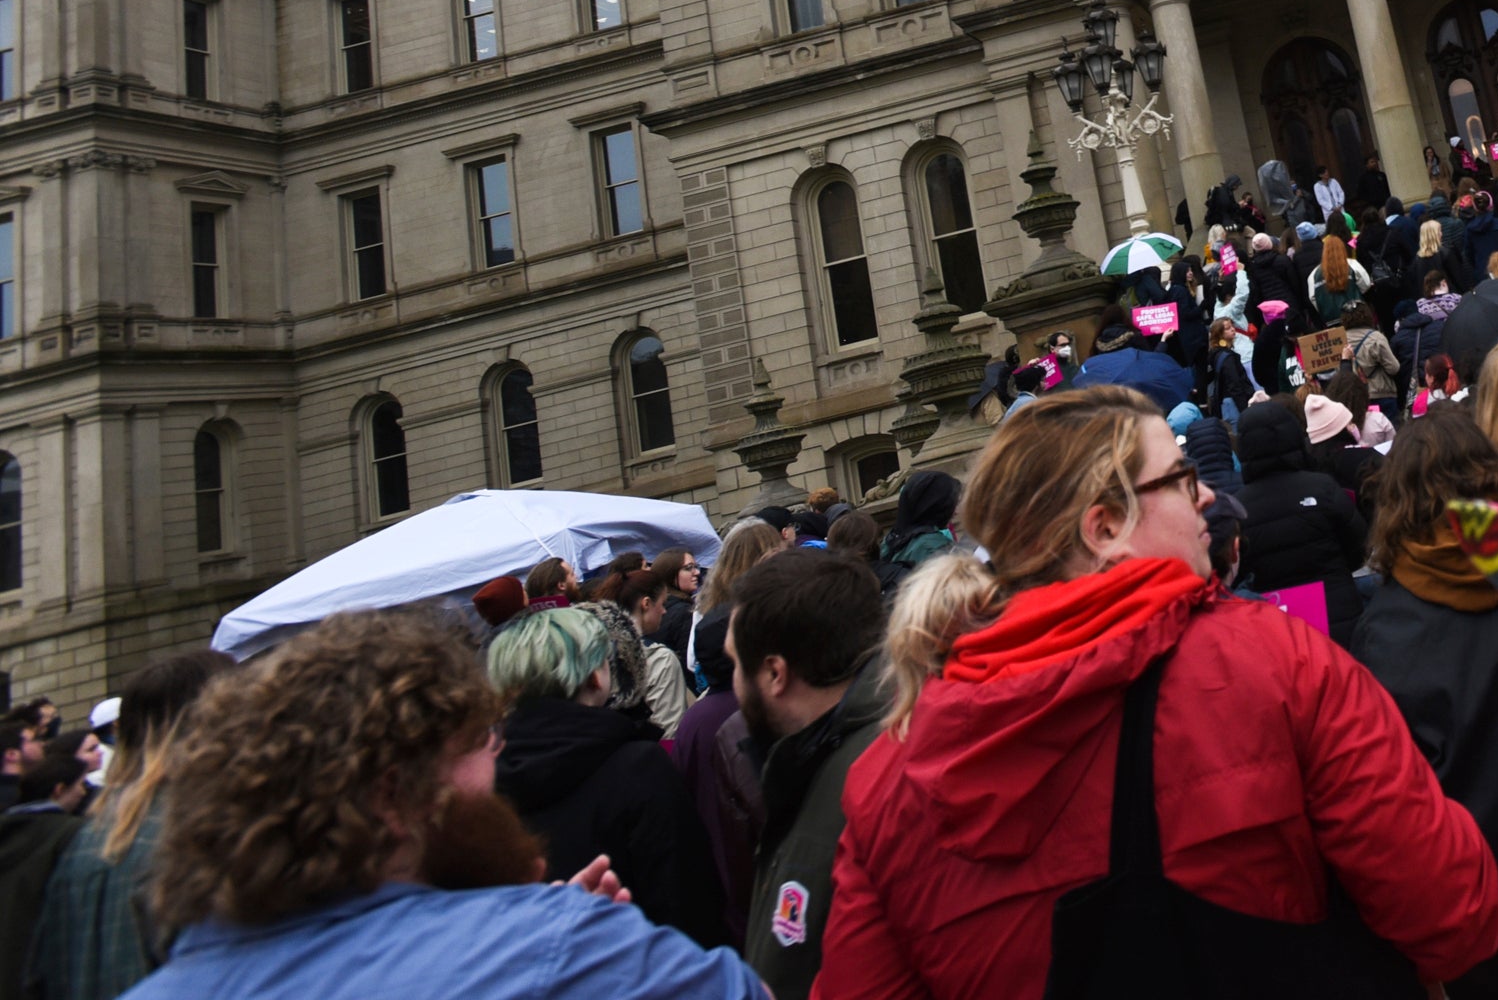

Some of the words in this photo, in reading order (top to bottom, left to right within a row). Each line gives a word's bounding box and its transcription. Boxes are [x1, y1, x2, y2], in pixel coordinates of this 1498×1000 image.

[1140, 306, 1169, 315] PROTECT
[1155, 311, 1175, 319] LEGAL
[1138, 317, 1173, 327] ABORTION
[1315, 332, 1329, 343] MY
[1312, 337, 1343, 352] UTERUS
[1311, 357, 1330, 368] FREE
